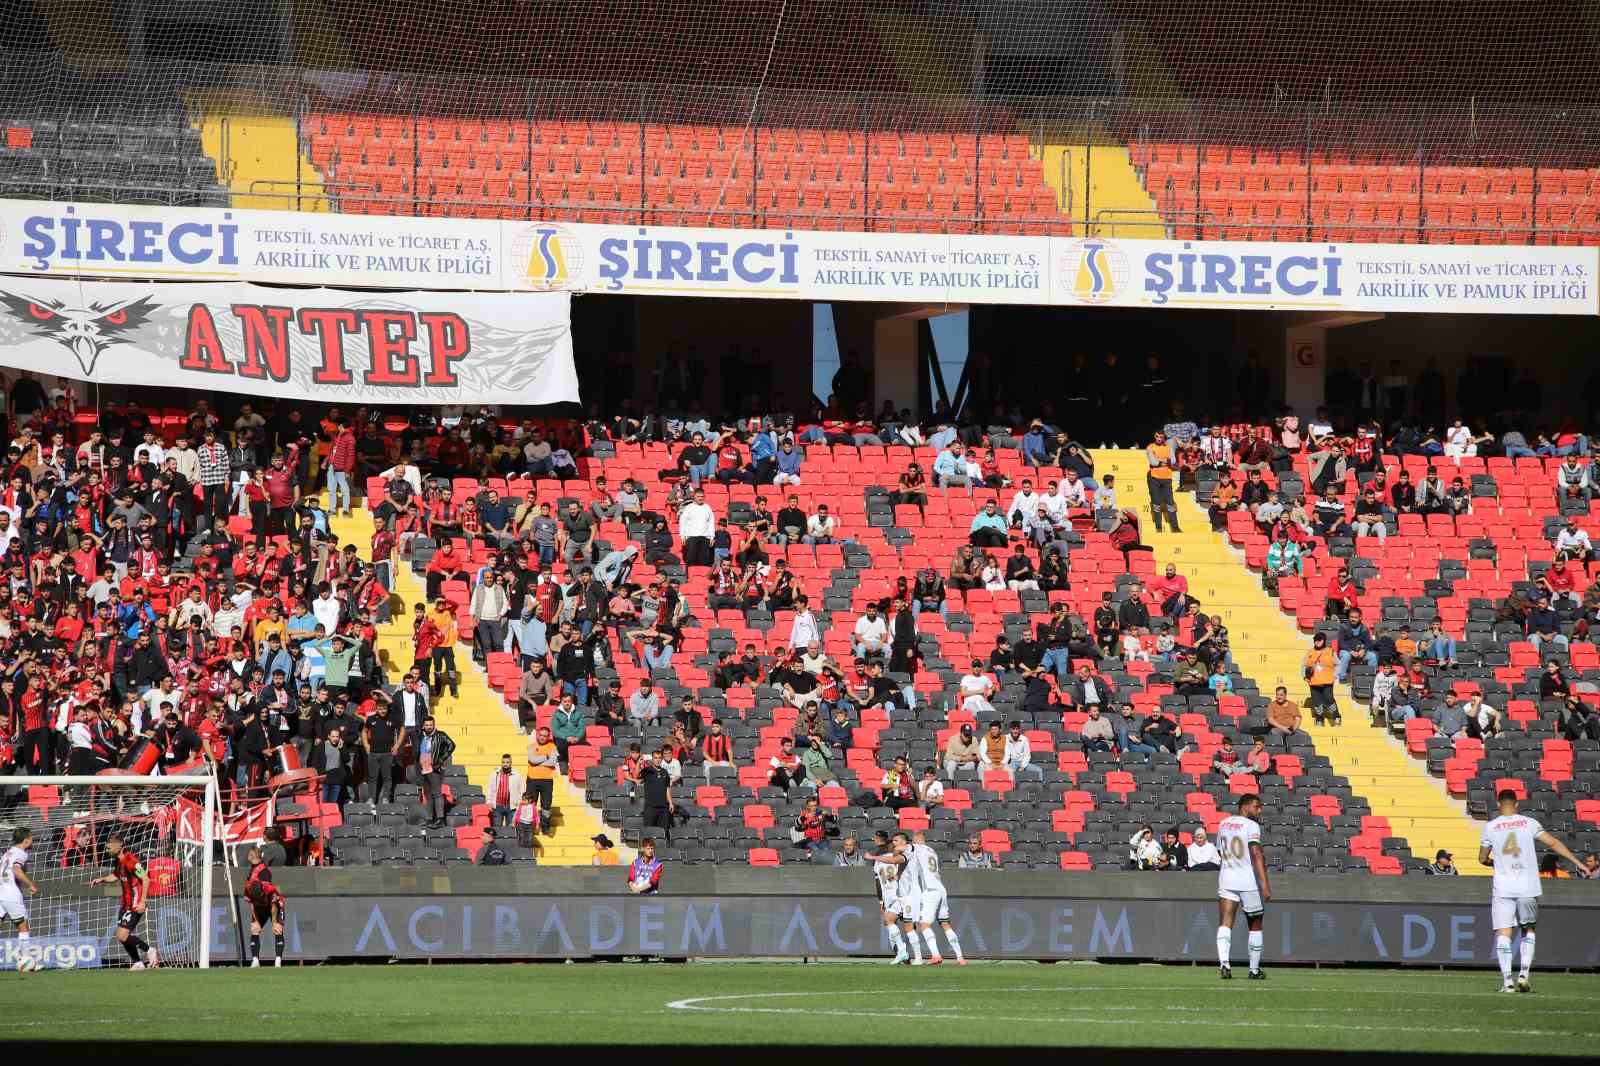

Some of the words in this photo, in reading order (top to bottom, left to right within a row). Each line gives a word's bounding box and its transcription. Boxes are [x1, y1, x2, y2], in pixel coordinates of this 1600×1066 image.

[23, 207, 238, 271] ŞİRECİ
[255, 227, 316, 244] TEKSTİL
[320, 231, 374, 248] SANAYİ
[379, 236, 394, 248] ve
[399, 233, 460, 250] TİCARET
[464, 238, 492, 254] A.Ş.
[254, 248, 331, 269] AKRİLİK
[336, 254, 360, 270] VE
[367, 255, 431, 273] PAMUK
[436, 256, 492, 275] İPLİĞİ
[599, 228, 799, 291] ŞİRECİ
[814, 248, 872, 264] TEKSTİL
[876, 249, 927, 265] SANAYİ
[931, 254, 947, 265] ve
[949, 250, 1010, 267] TİCARET
[1014, 254, 1041, 270] A.Ş.
[1356, 261, 1415, 276] TEKSTİL
[1419, 261, 1471, 277] SANAYİ
[1476, 266, 1491, 277] ve
[1496, 262, 1557, 277] TİCARET
[1561, 264, 1588, 280] A.Ş.
[814, 267, 886, 286] AKRİLİK
[891, 271, 914, 287] VE
[920, 272, 982, 289] PAMUK
[987, 269, 1041, 289] İPLİĞİ
[1144, 243, 1341, 304] ŞİRECİ
[1356, 279, 1429, 298] AKRİLİK
[1434, 283, 1457, 298] VE
[1463, 283, 1527, 299] PAMUK
[1532, 280, 1588, 300] İPLİĞİ
[180, 301, 470, 387] ANTEP
[1502, 832, 1522, 858] 4
[928, 856, 937, 873] 9
[355, 903, 729, 953] ACIBADEM
[780, 904, 1134, 954] ACIADEM
